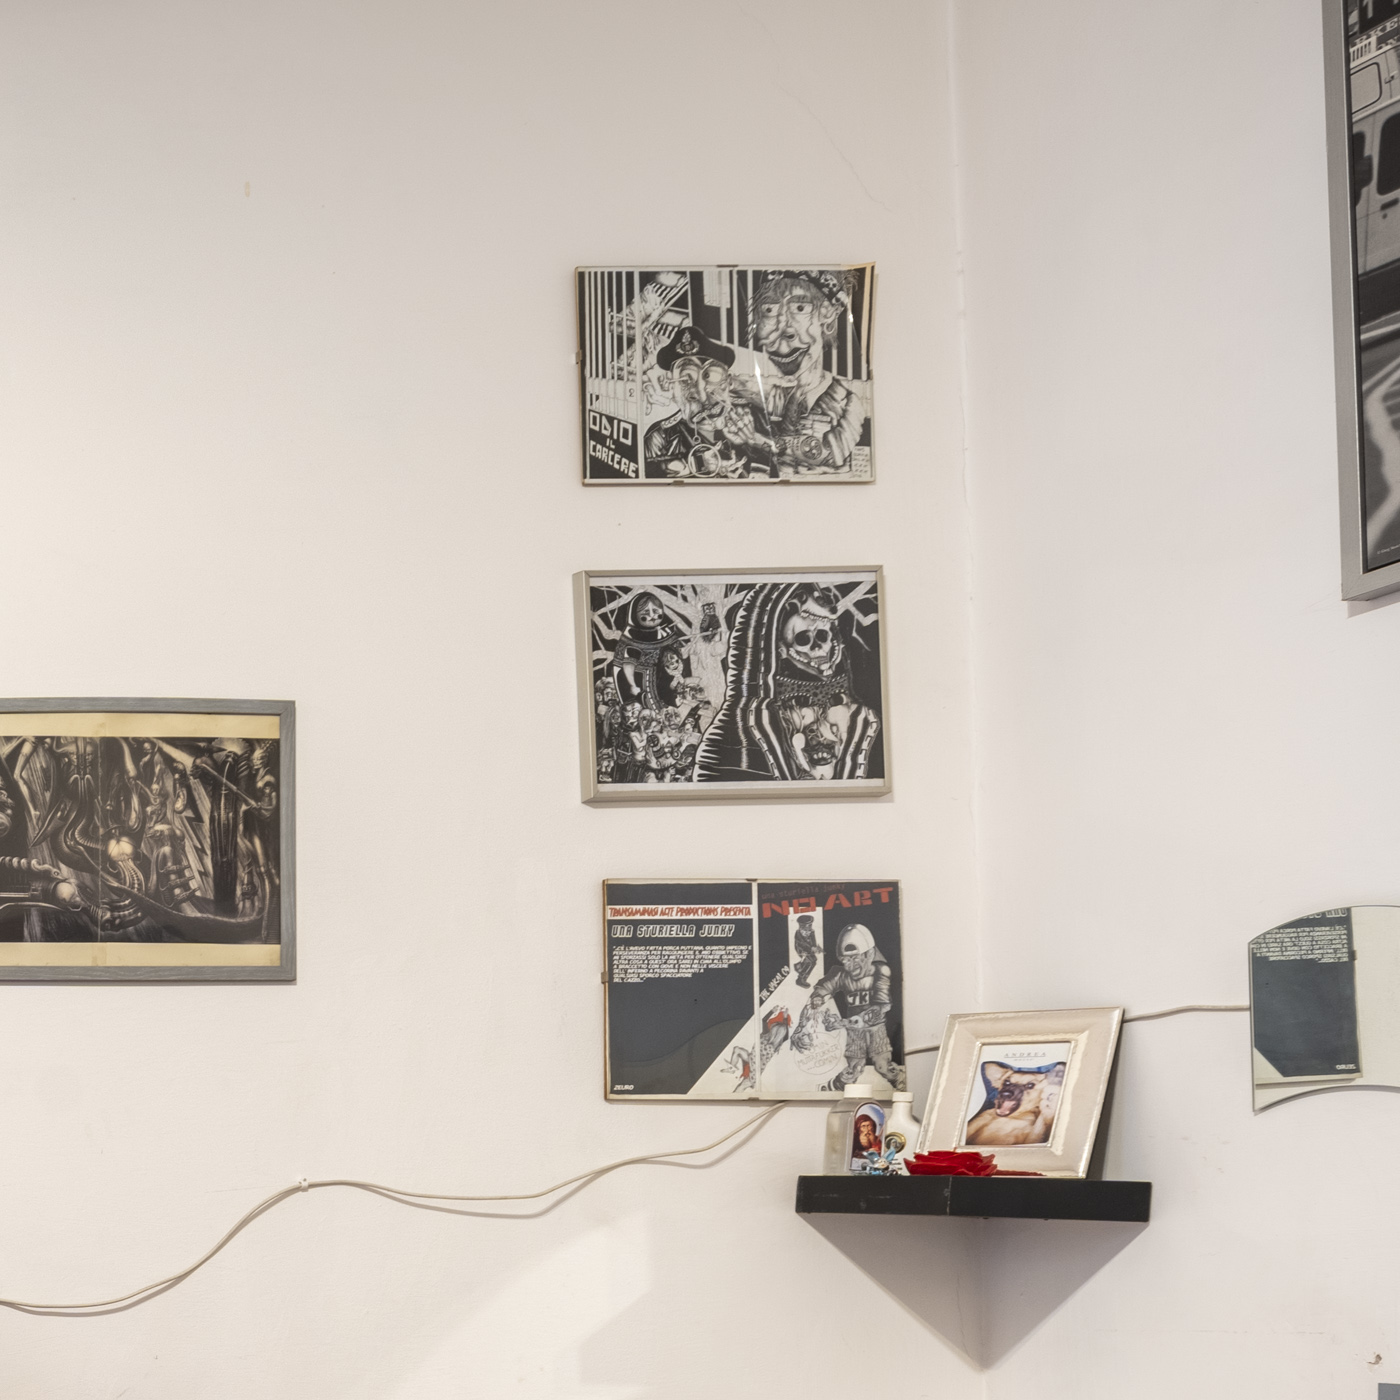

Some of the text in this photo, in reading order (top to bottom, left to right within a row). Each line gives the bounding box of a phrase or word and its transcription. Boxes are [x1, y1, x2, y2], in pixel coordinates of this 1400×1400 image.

[590, 411, 632, 446] ODIO
[606, 438, 615, 449] IL
[590, 440, 638, 478] CARCERE
[762, 887, 893, 918] NO ART
[611, 924, 735, 937] UNA STURIELLA JUNKY
